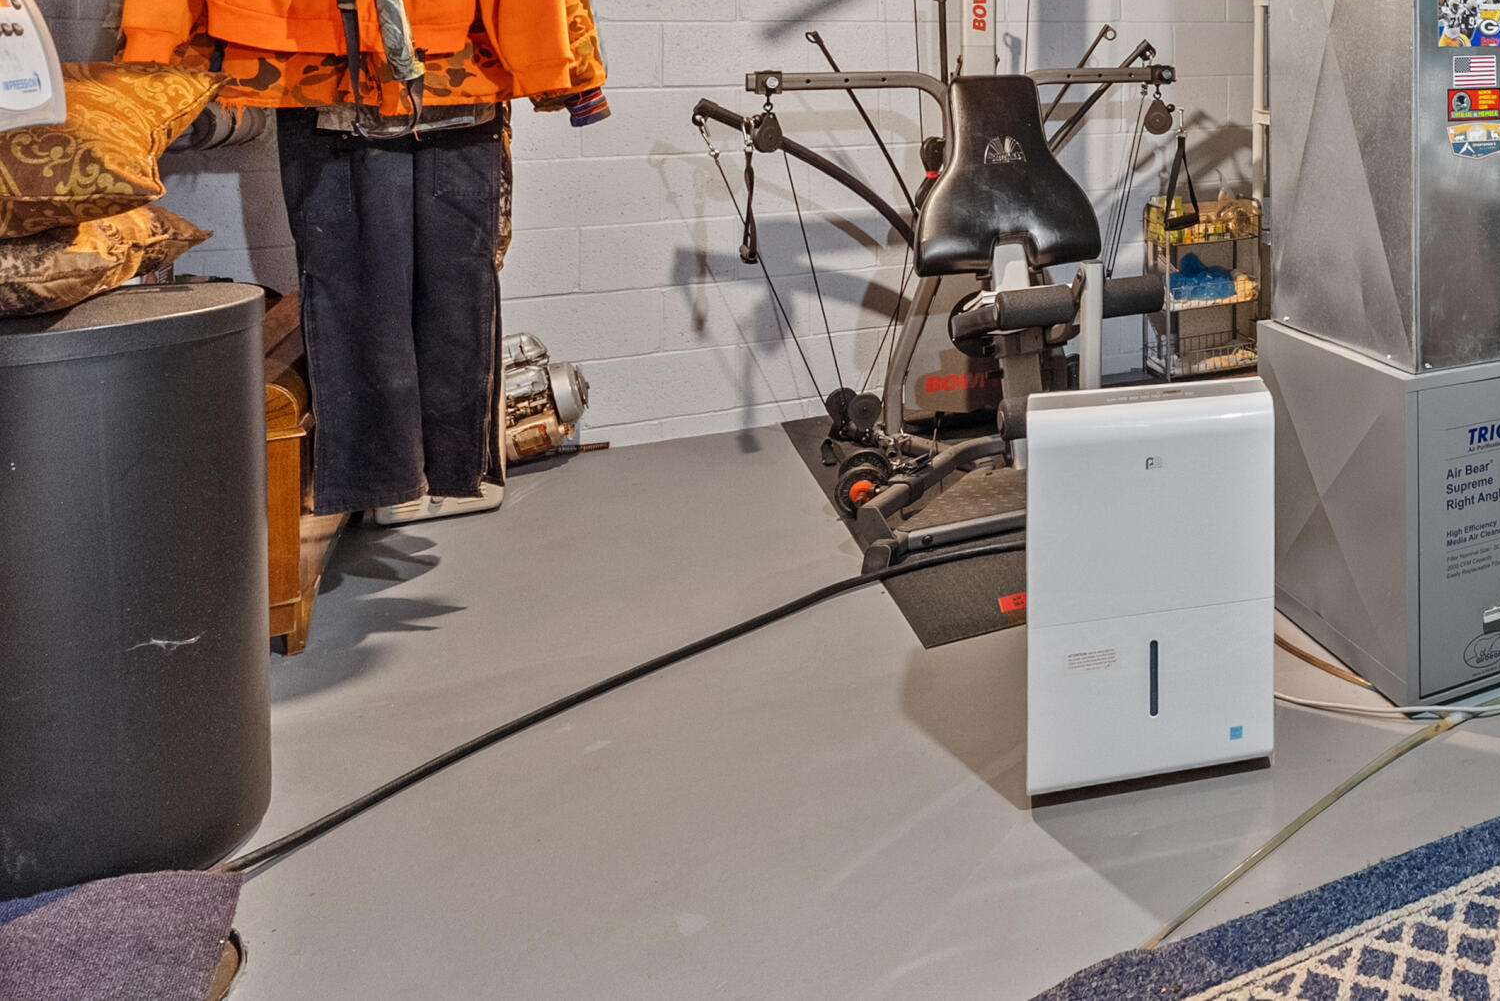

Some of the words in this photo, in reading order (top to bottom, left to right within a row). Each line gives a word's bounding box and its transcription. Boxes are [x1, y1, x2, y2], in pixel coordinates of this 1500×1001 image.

[1446, 468, 1462, 480] Air
[1465, 462, 1490, 476] Bear
[1446, 476, 1494, 495] Supreme
[1446, 495, 1475, 511] Right
[1447, 528, 1463, 538] High
[1464, 520, 1497, 534] Efficiency
[1447, 537, 1467, 547] Media
[1468, 533, 1479, 541] Air
